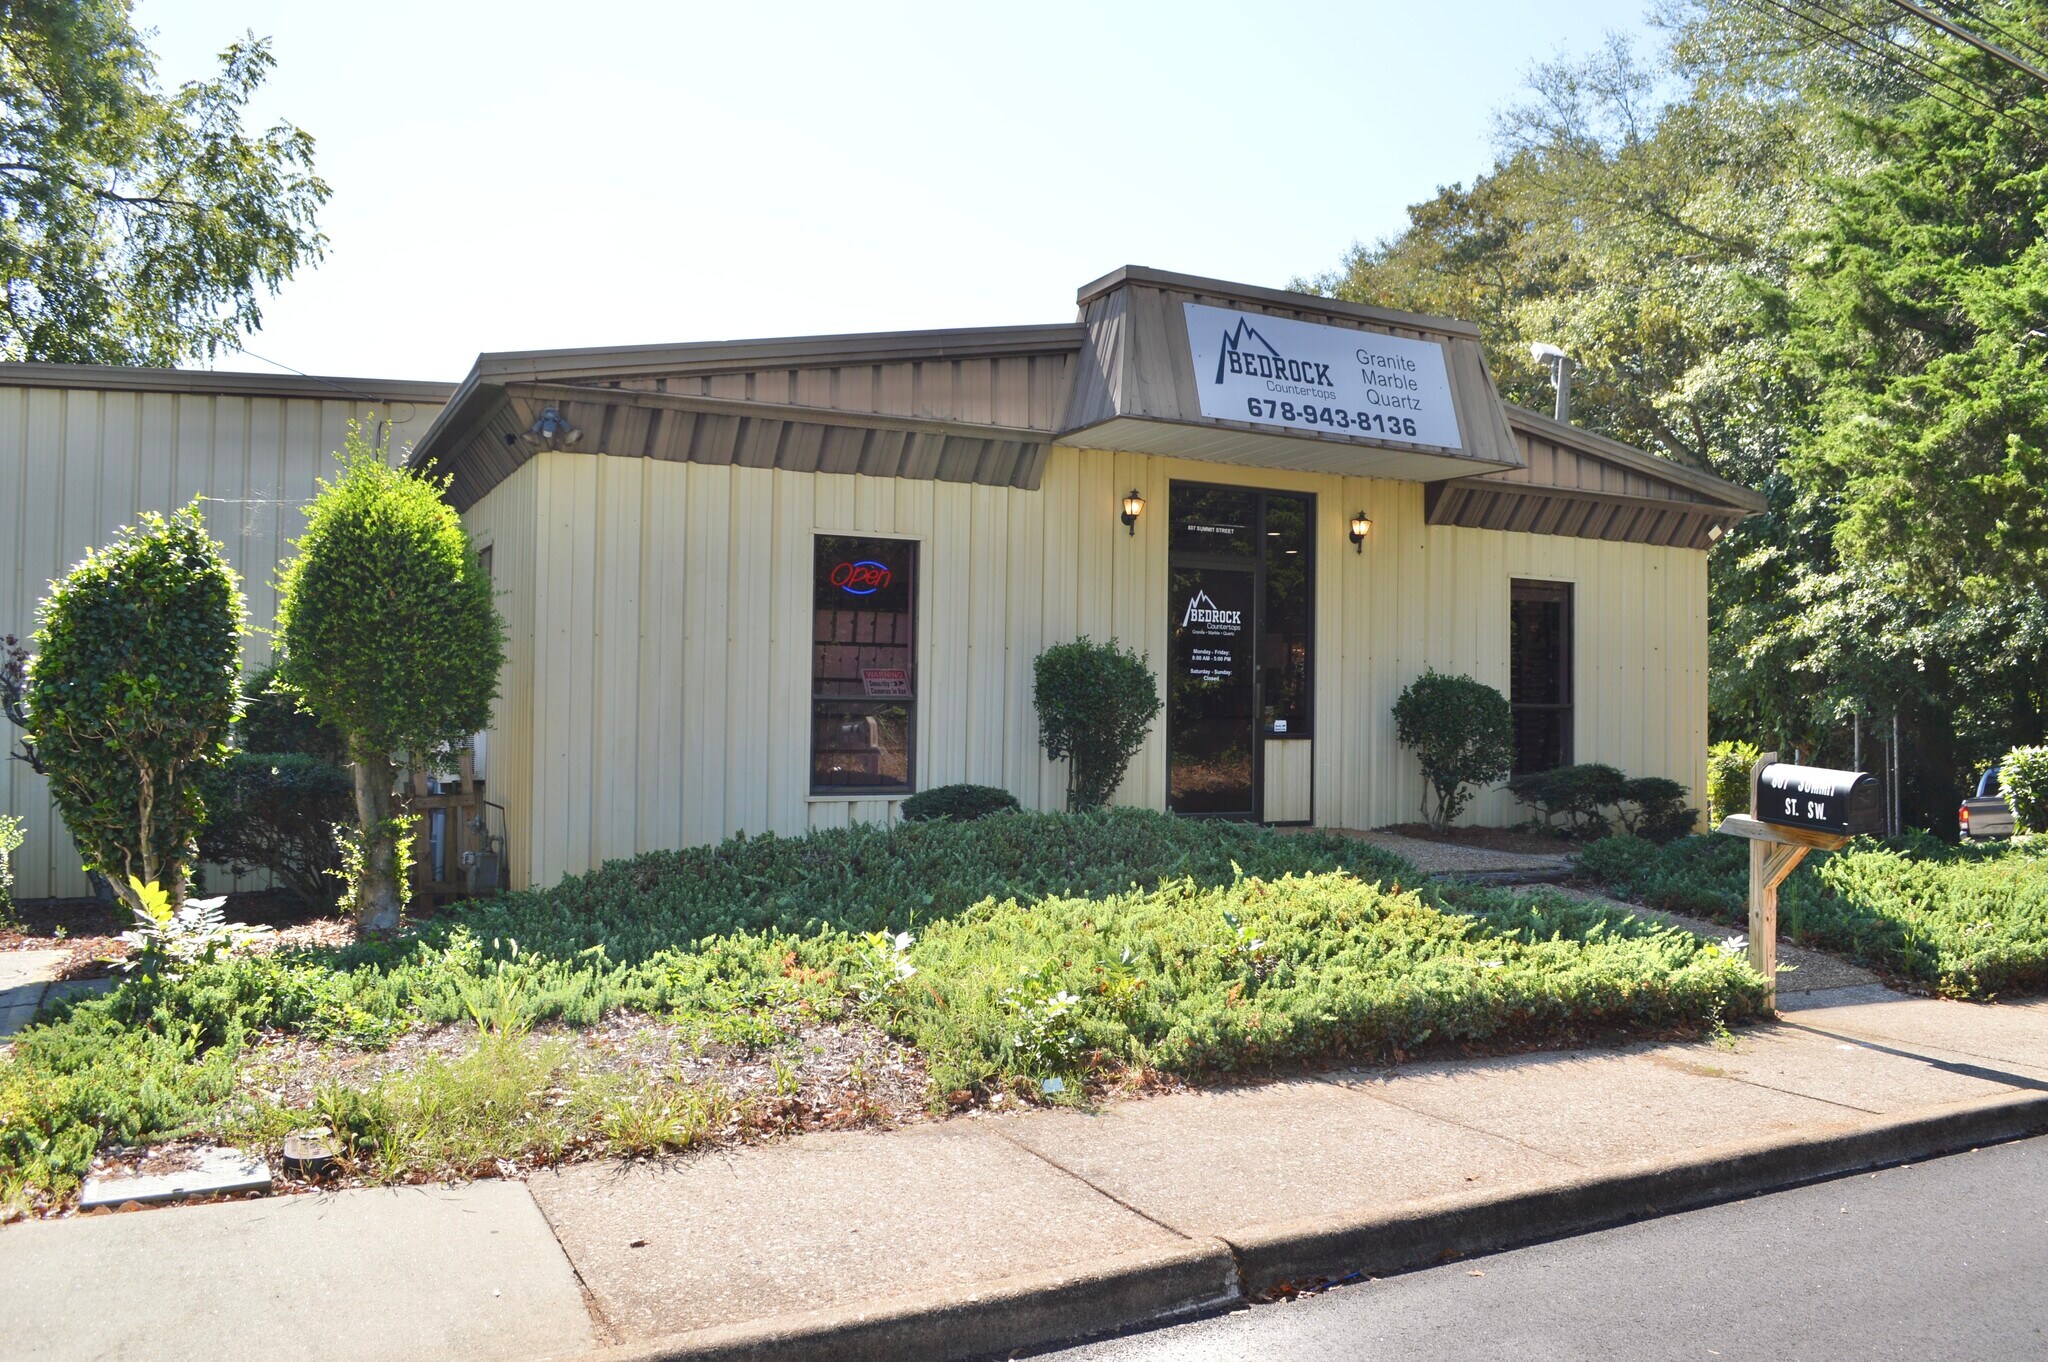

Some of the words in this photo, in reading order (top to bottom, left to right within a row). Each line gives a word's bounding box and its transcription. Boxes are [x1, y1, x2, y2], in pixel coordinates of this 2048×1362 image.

[1227, 350, 1334, 387] BEDROCK
[1355, 349, 1416, 372] Granite
[1266, 380, 1337, 400] Countertops
[1362, 369, 1418, 391] Marble
[1366, 389, 1422, 411] Quartz
[1247, 397, 1417, 437] 678-943-8136
[1196, 525, 1215, 533] SUMMIT
[1215, 527, 1234, 535] STREET
[831, 562, 892, 588] Open
[1190, 608, 1241, 624] BEDROCK
[1206, 622, 1241, 632] Countertops
[1193, 648, 1211, 656] Monday
[1190, 668, 1210, 676] Saturday
[869, 680, 890, 688] Security
[1785, 797, 1799, 816] ST.
[1807, 801, 1827, 820] SW.
